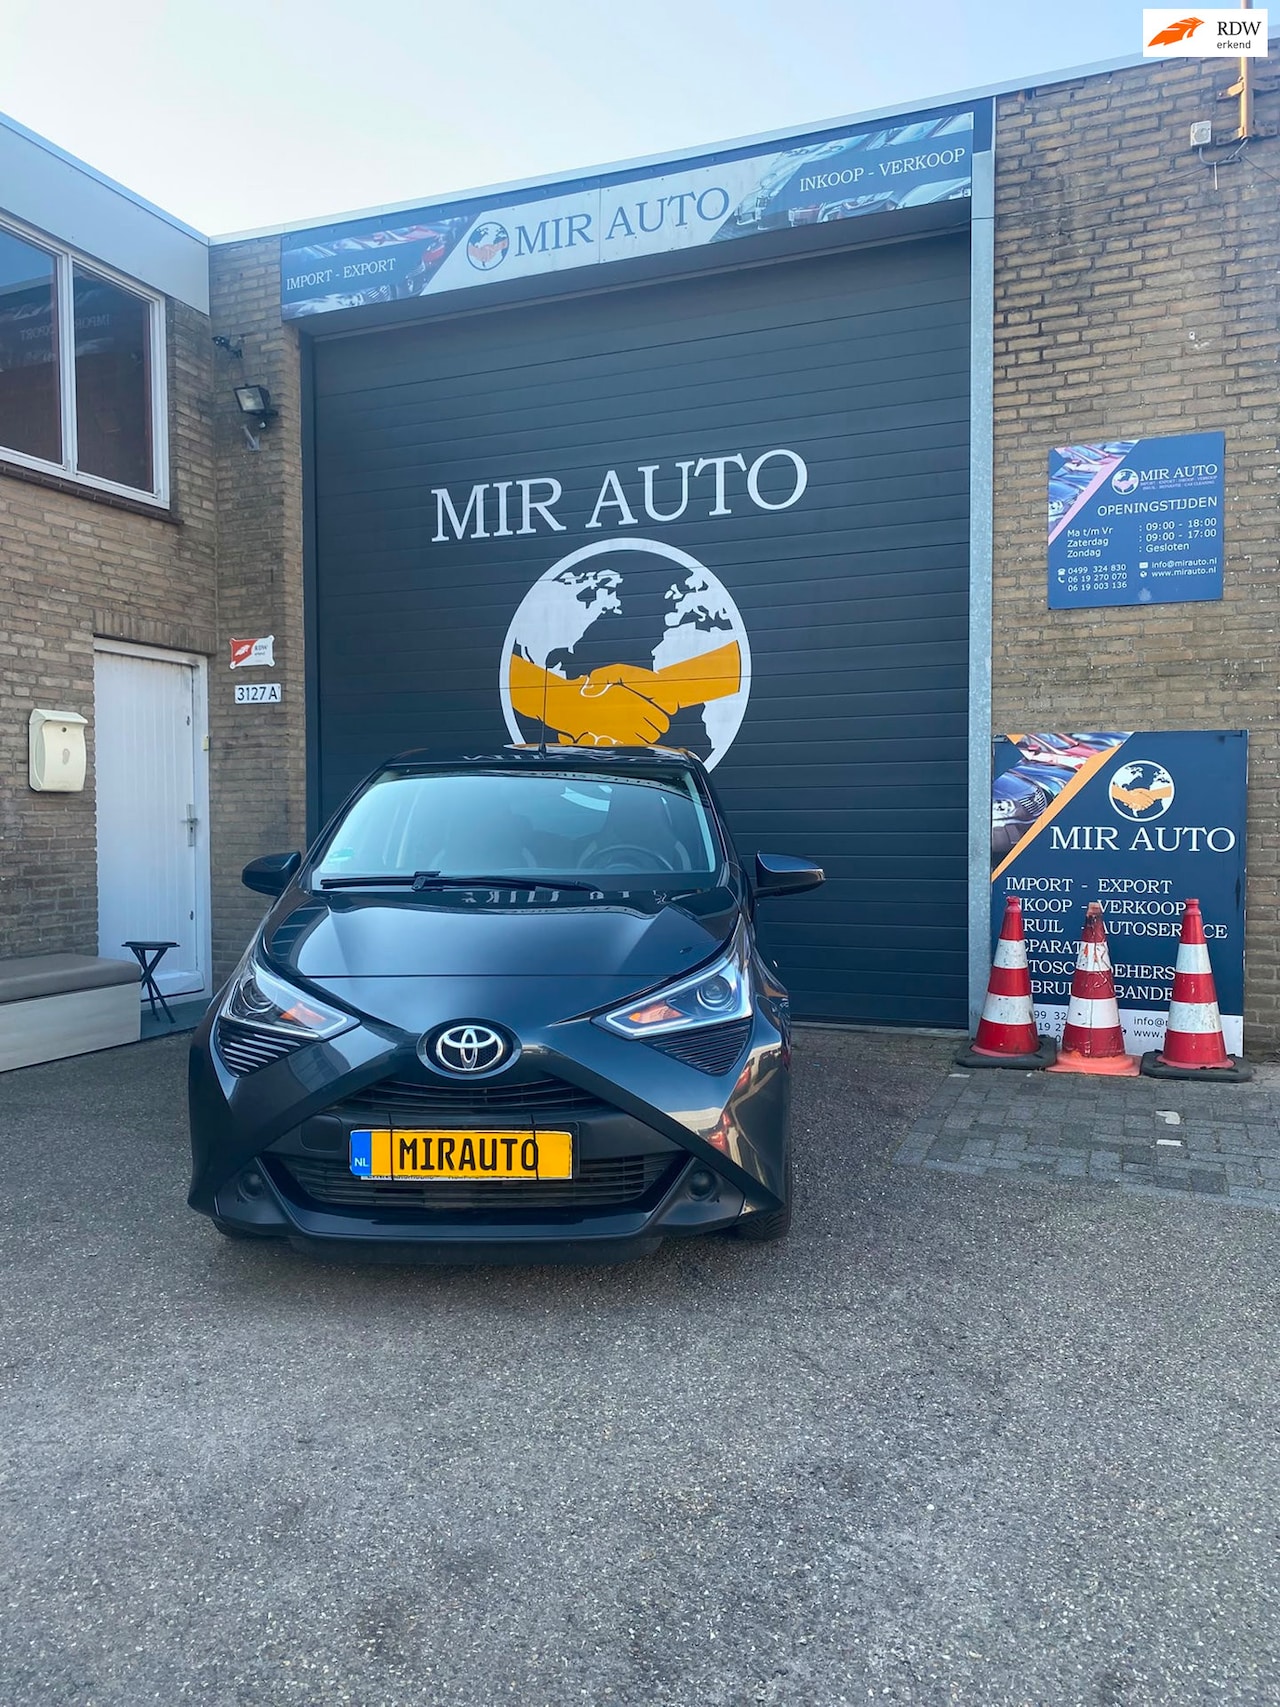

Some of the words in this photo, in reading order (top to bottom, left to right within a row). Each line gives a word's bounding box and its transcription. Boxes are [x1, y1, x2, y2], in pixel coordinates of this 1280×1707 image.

[799, 167, 865, 192] INKOOP
[879, 147, 966, 177] VERKOOP
[514, 212, 595, 257] MIR
[605, 187, 730, 241] AUTO
[286, 268, 333, 291] IMPORT
[343, 257, 397, 279] EXPORT
[1140, 468, 1170, 482] MIR
[1173, 463, 1218, 479] AUTO
[431, 477, 567, 542] MIR
[585, 449, 808, 529] AUTO
[1097, 496, 1218, 517] OPENINGSTIJDEN
[1067, 529, 1080, 538] Ma
[1083, 528, 1100, 536] t/m
[1102, 526, 1113, 535] Vr
[1146, 521, 1175, 531] 09:00
[1188, 517, 1217, 528] 18:00
[1067, 537, 1109, 548] Zaterdag
[1146, 532, 1175, 542] 09:00
[1188, 528, 1217, 539] 17:00
[1067, 548, 1101, 559] Zondag
[1146, 542, 1190, 553] Gesloten
[1068, 566, 1088, 575] 0499
[1092, 565, 1108, 573] 324
[1110, 563, 1127, 571] 830
[1151, 566, 1217, 577] www.mirauto.nl
[1152, 557, 1217, 569] info@mirauto.nl
[1068, 575, 1078, 583] 06
[1081, 574, 1091, 582] 19
[1094, 573, 1109, 581] 270
[1112, 572, 1127, 580] 070
[1068, 584, 1078, 592] 06
[1081, 583, 1091, 591] 19
[1093, 582, 1109, 590] 003
[1112, 581, 1127, 589] 136
[237, 686, 267, 701] 3127
[268, 686, 278, 700] A
[1050, 826, 1120, 851] MIR
[1128, 826, 1236, 852] AUTO
[1006, 876, 1074, 892] IMPORT
[1098, 878, 1174, 894] EXPORT
[1020, 898, 1072, 913] KOOP
[1097, 899, 1187, 916] VERKOOP
[1022, 918, 1064, 933] RUIL
[1103, 920, 1228, 939] UTOSERCE
[1113, 984, 1173, 1001] BANDE
[1034, 1010, 1047, 1020] 99
[1054, 1011, 1067, 1021] 32
[354, 1157, 369, 1167] NL
[399, 1138, 540, 1171] MIRAUTO
